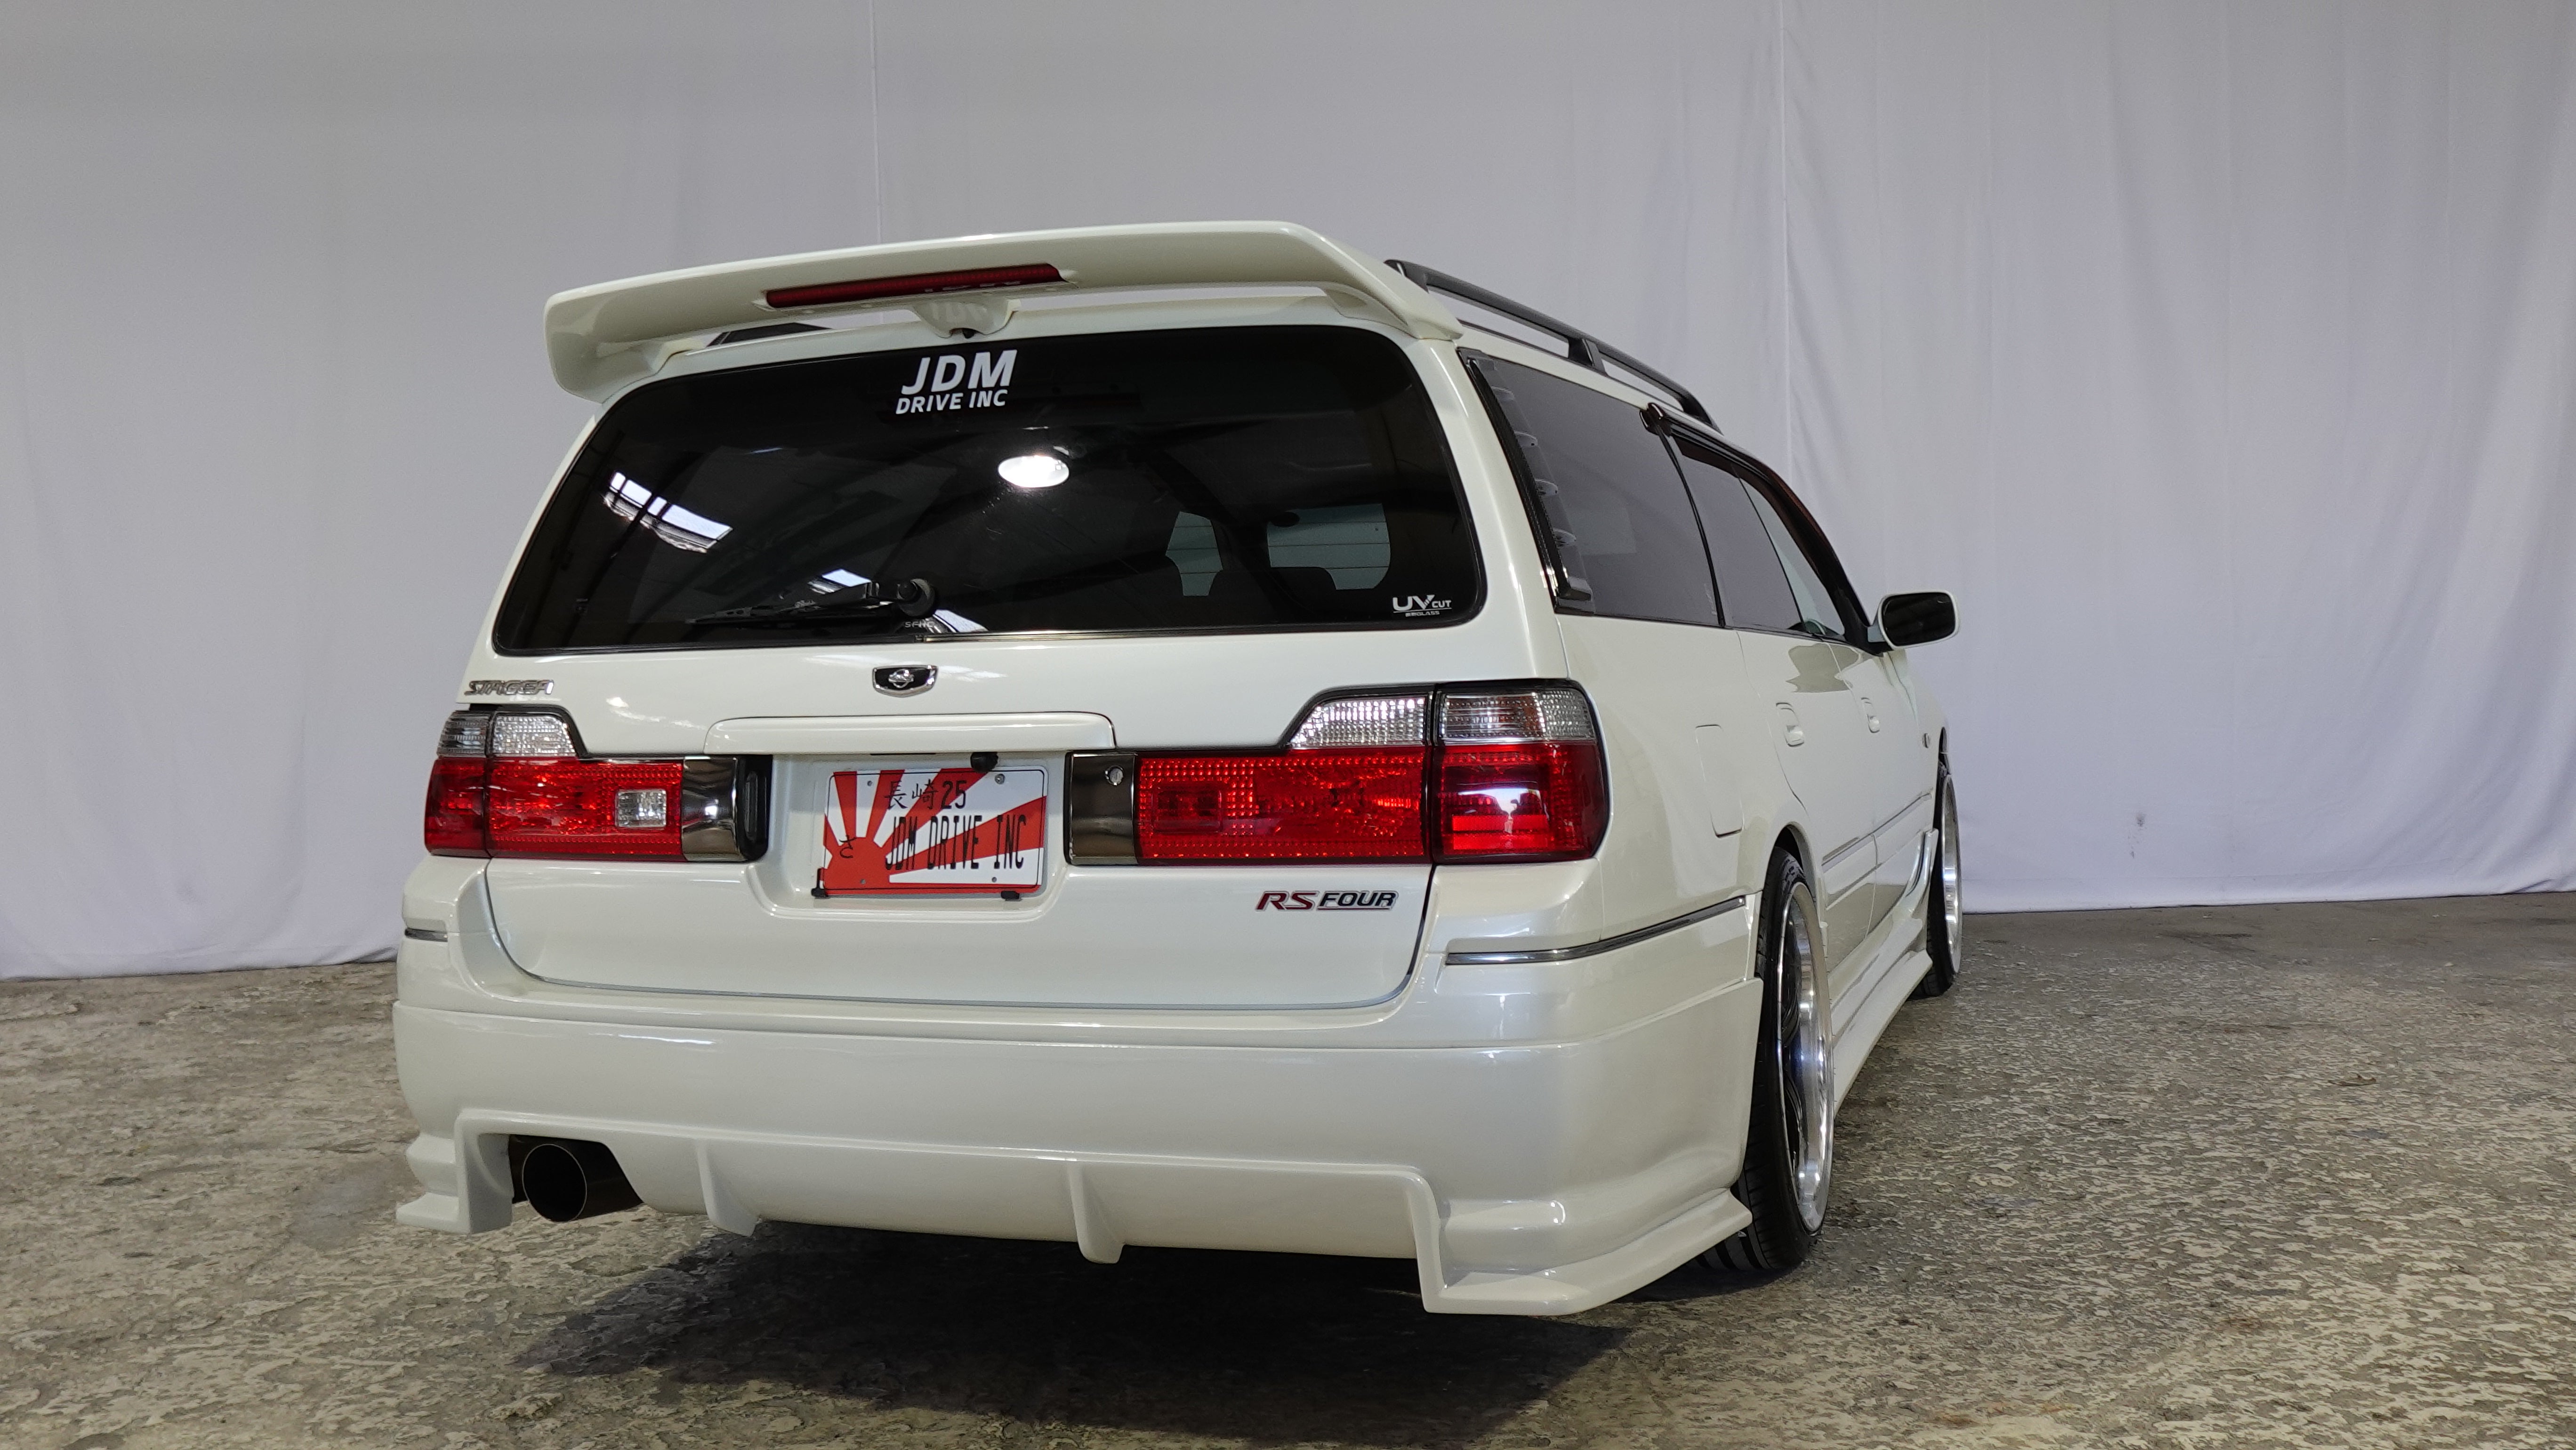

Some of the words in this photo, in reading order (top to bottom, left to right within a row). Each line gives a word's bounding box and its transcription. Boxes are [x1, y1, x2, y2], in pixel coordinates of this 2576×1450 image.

[901, 349, 1018, 395] JDM
[895, 393, 964, 415] DRIVE
[969, 389, 1008, 408] INC
[1393, 595, 1435, 611] UV
[1432, 600, 1452, 608] CUT
[464, 680, 554, 695] STAGEA
[839, 834, 857, 859] さ
[885, 816, 918, 870] JDM
[926, 814, 982, 870] DRIVE
[993, 814, 1027, 870] INC
[1256, 891, 1320, 911] RS
[1318, 891, 1399, 909] FOUR
